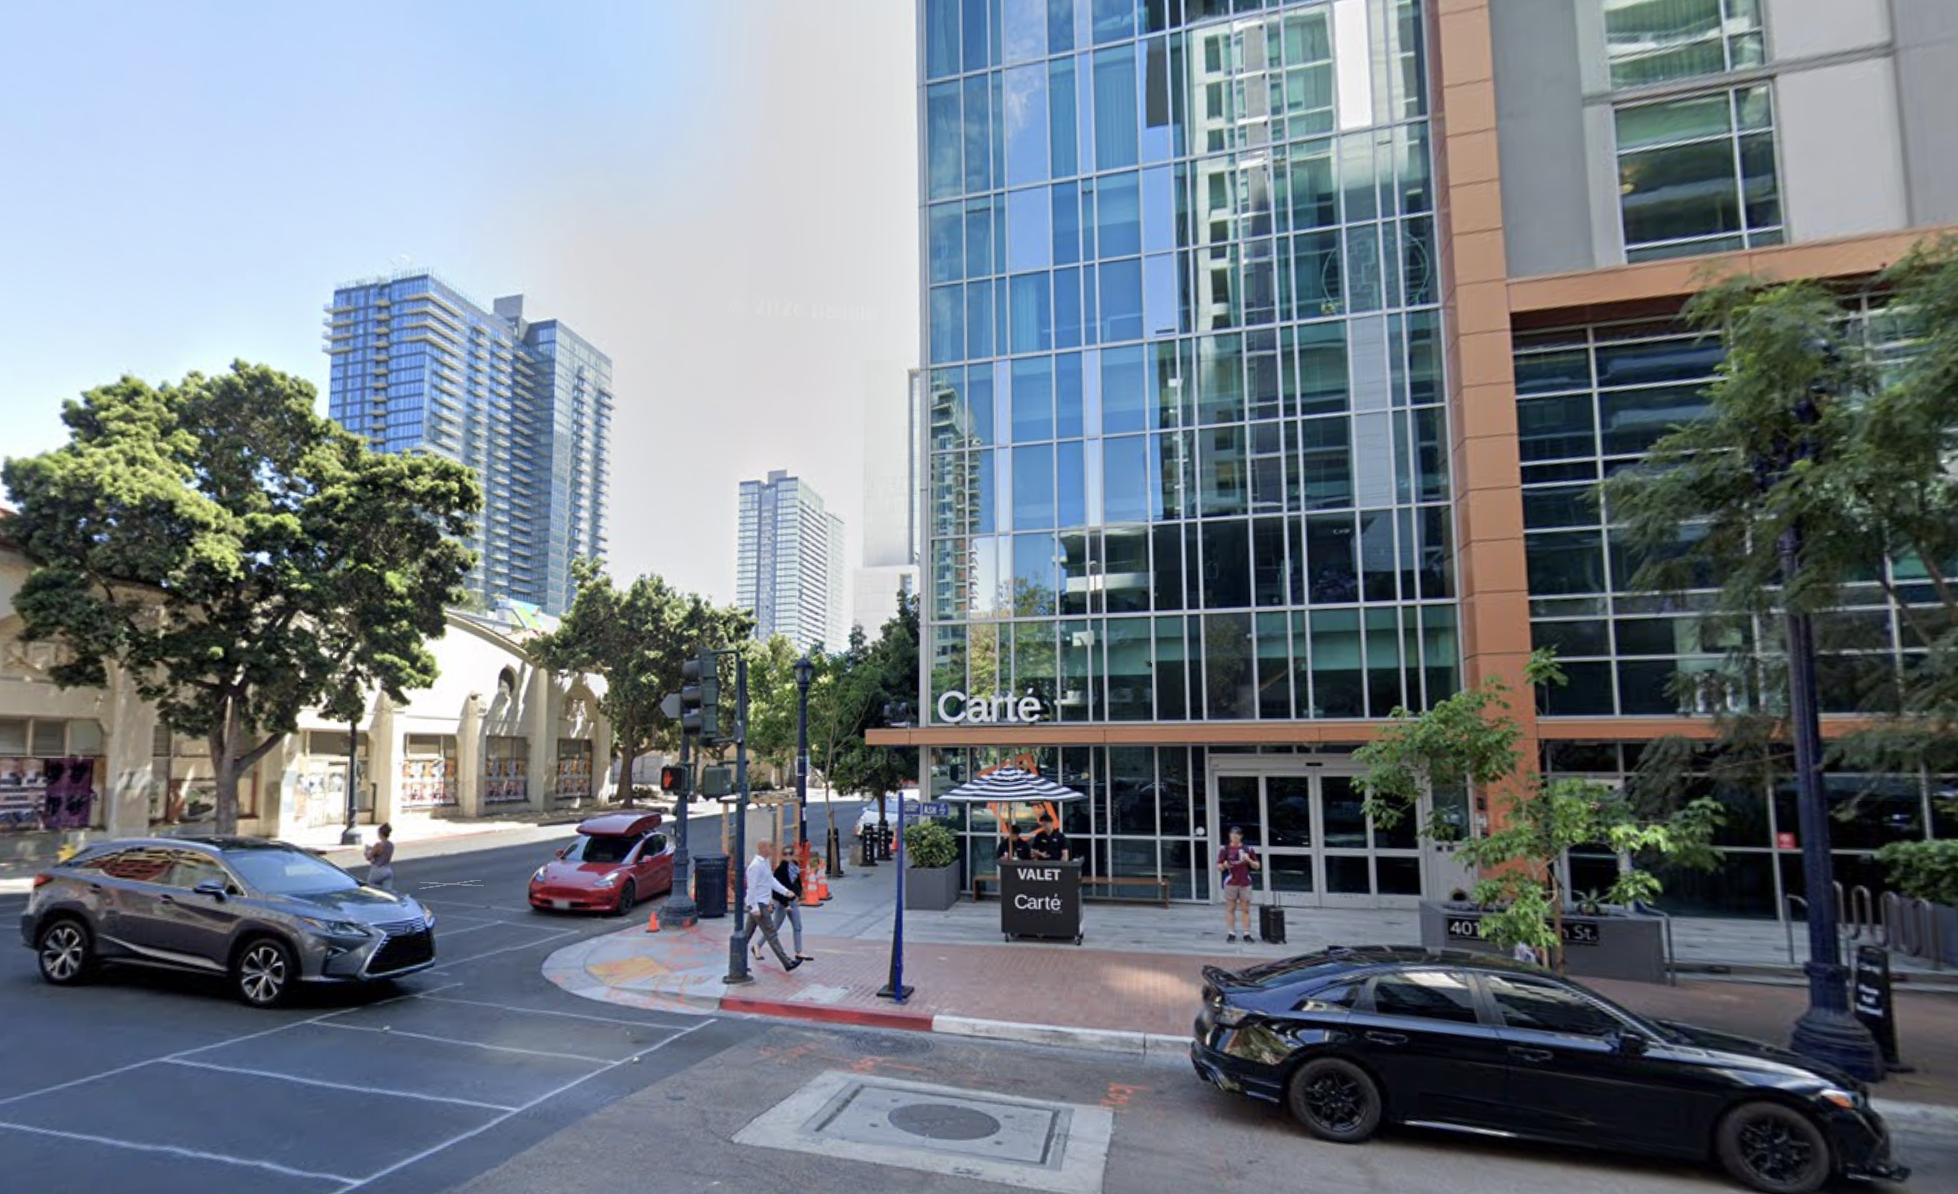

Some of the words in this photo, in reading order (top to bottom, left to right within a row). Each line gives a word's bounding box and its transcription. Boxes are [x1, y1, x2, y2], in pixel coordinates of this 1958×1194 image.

[937, 687, 1041, 723] Carté
[1017, 868, 1061, 881] VALET
[1014, 893, 1062, 911] Carté
